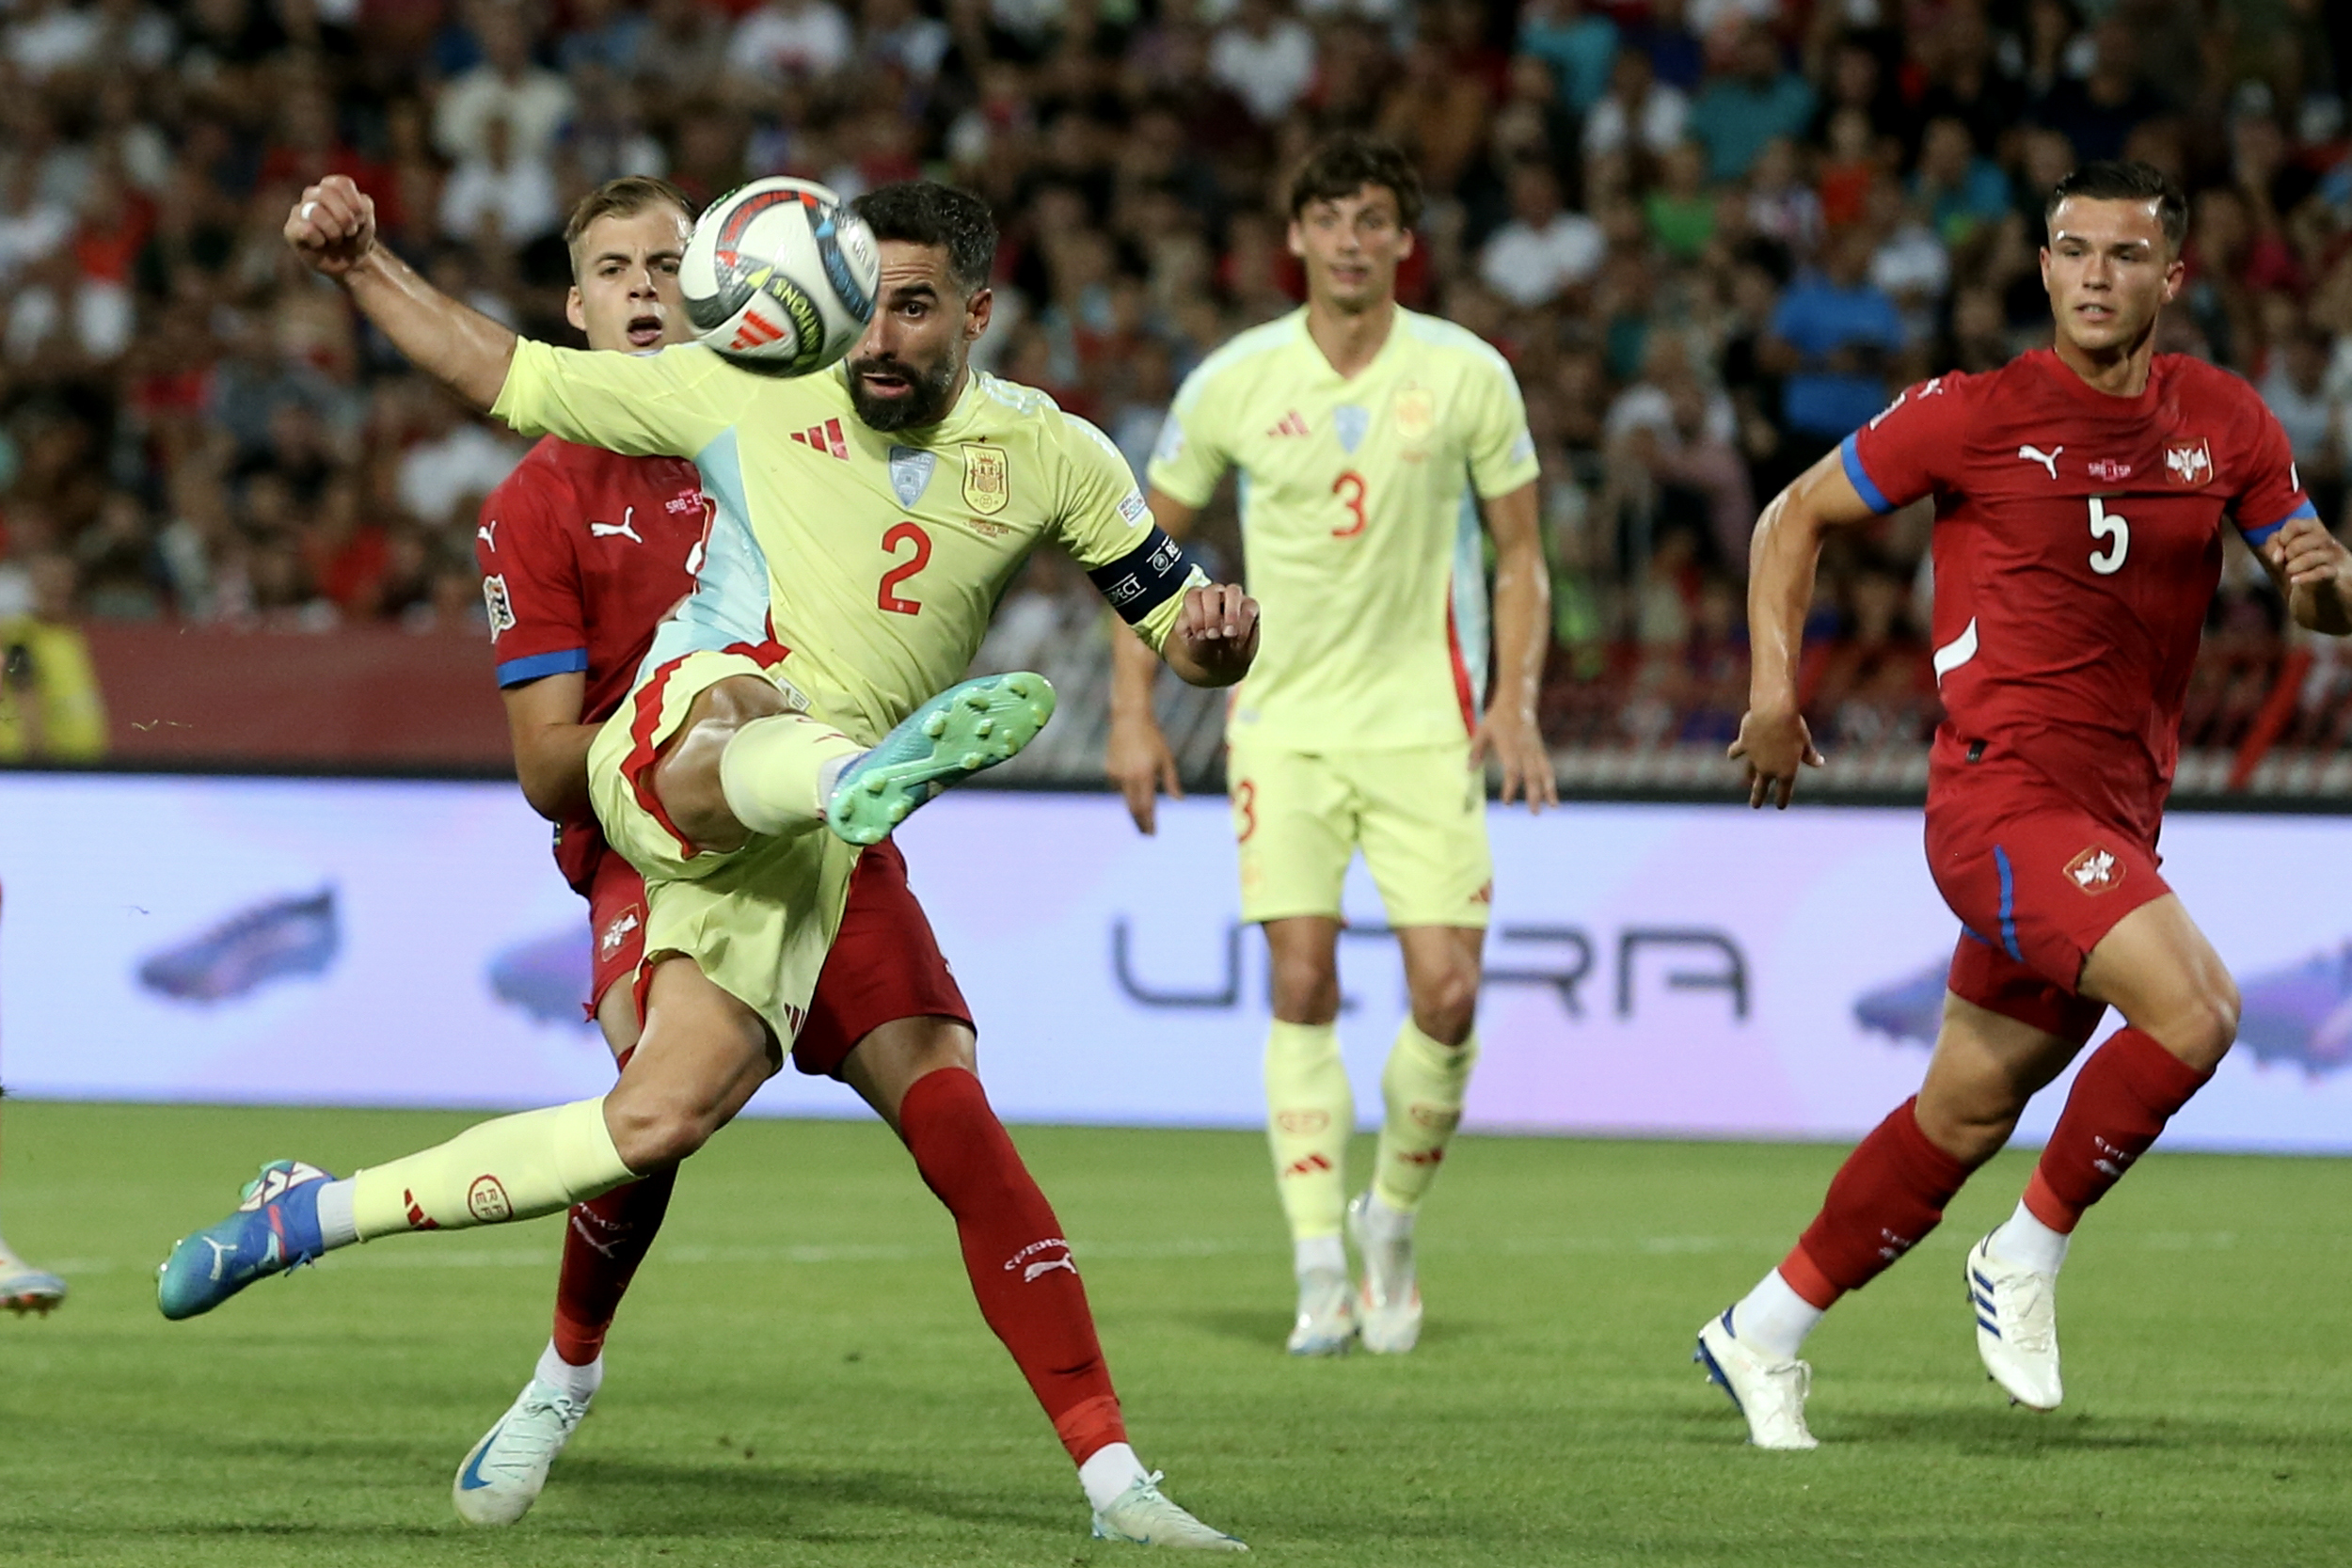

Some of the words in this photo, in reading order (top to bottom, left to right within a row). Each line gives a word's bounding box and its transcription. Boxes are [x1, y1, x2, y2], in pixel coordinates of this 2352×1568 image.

[1331, 469, 1366, 537] 3
[2089, 496, 2129, 575] 5
[878, 520, 932, 616] 2
[1236, 779, 1256, 843] 3
[1111, 917, 1753, 1020] URA
